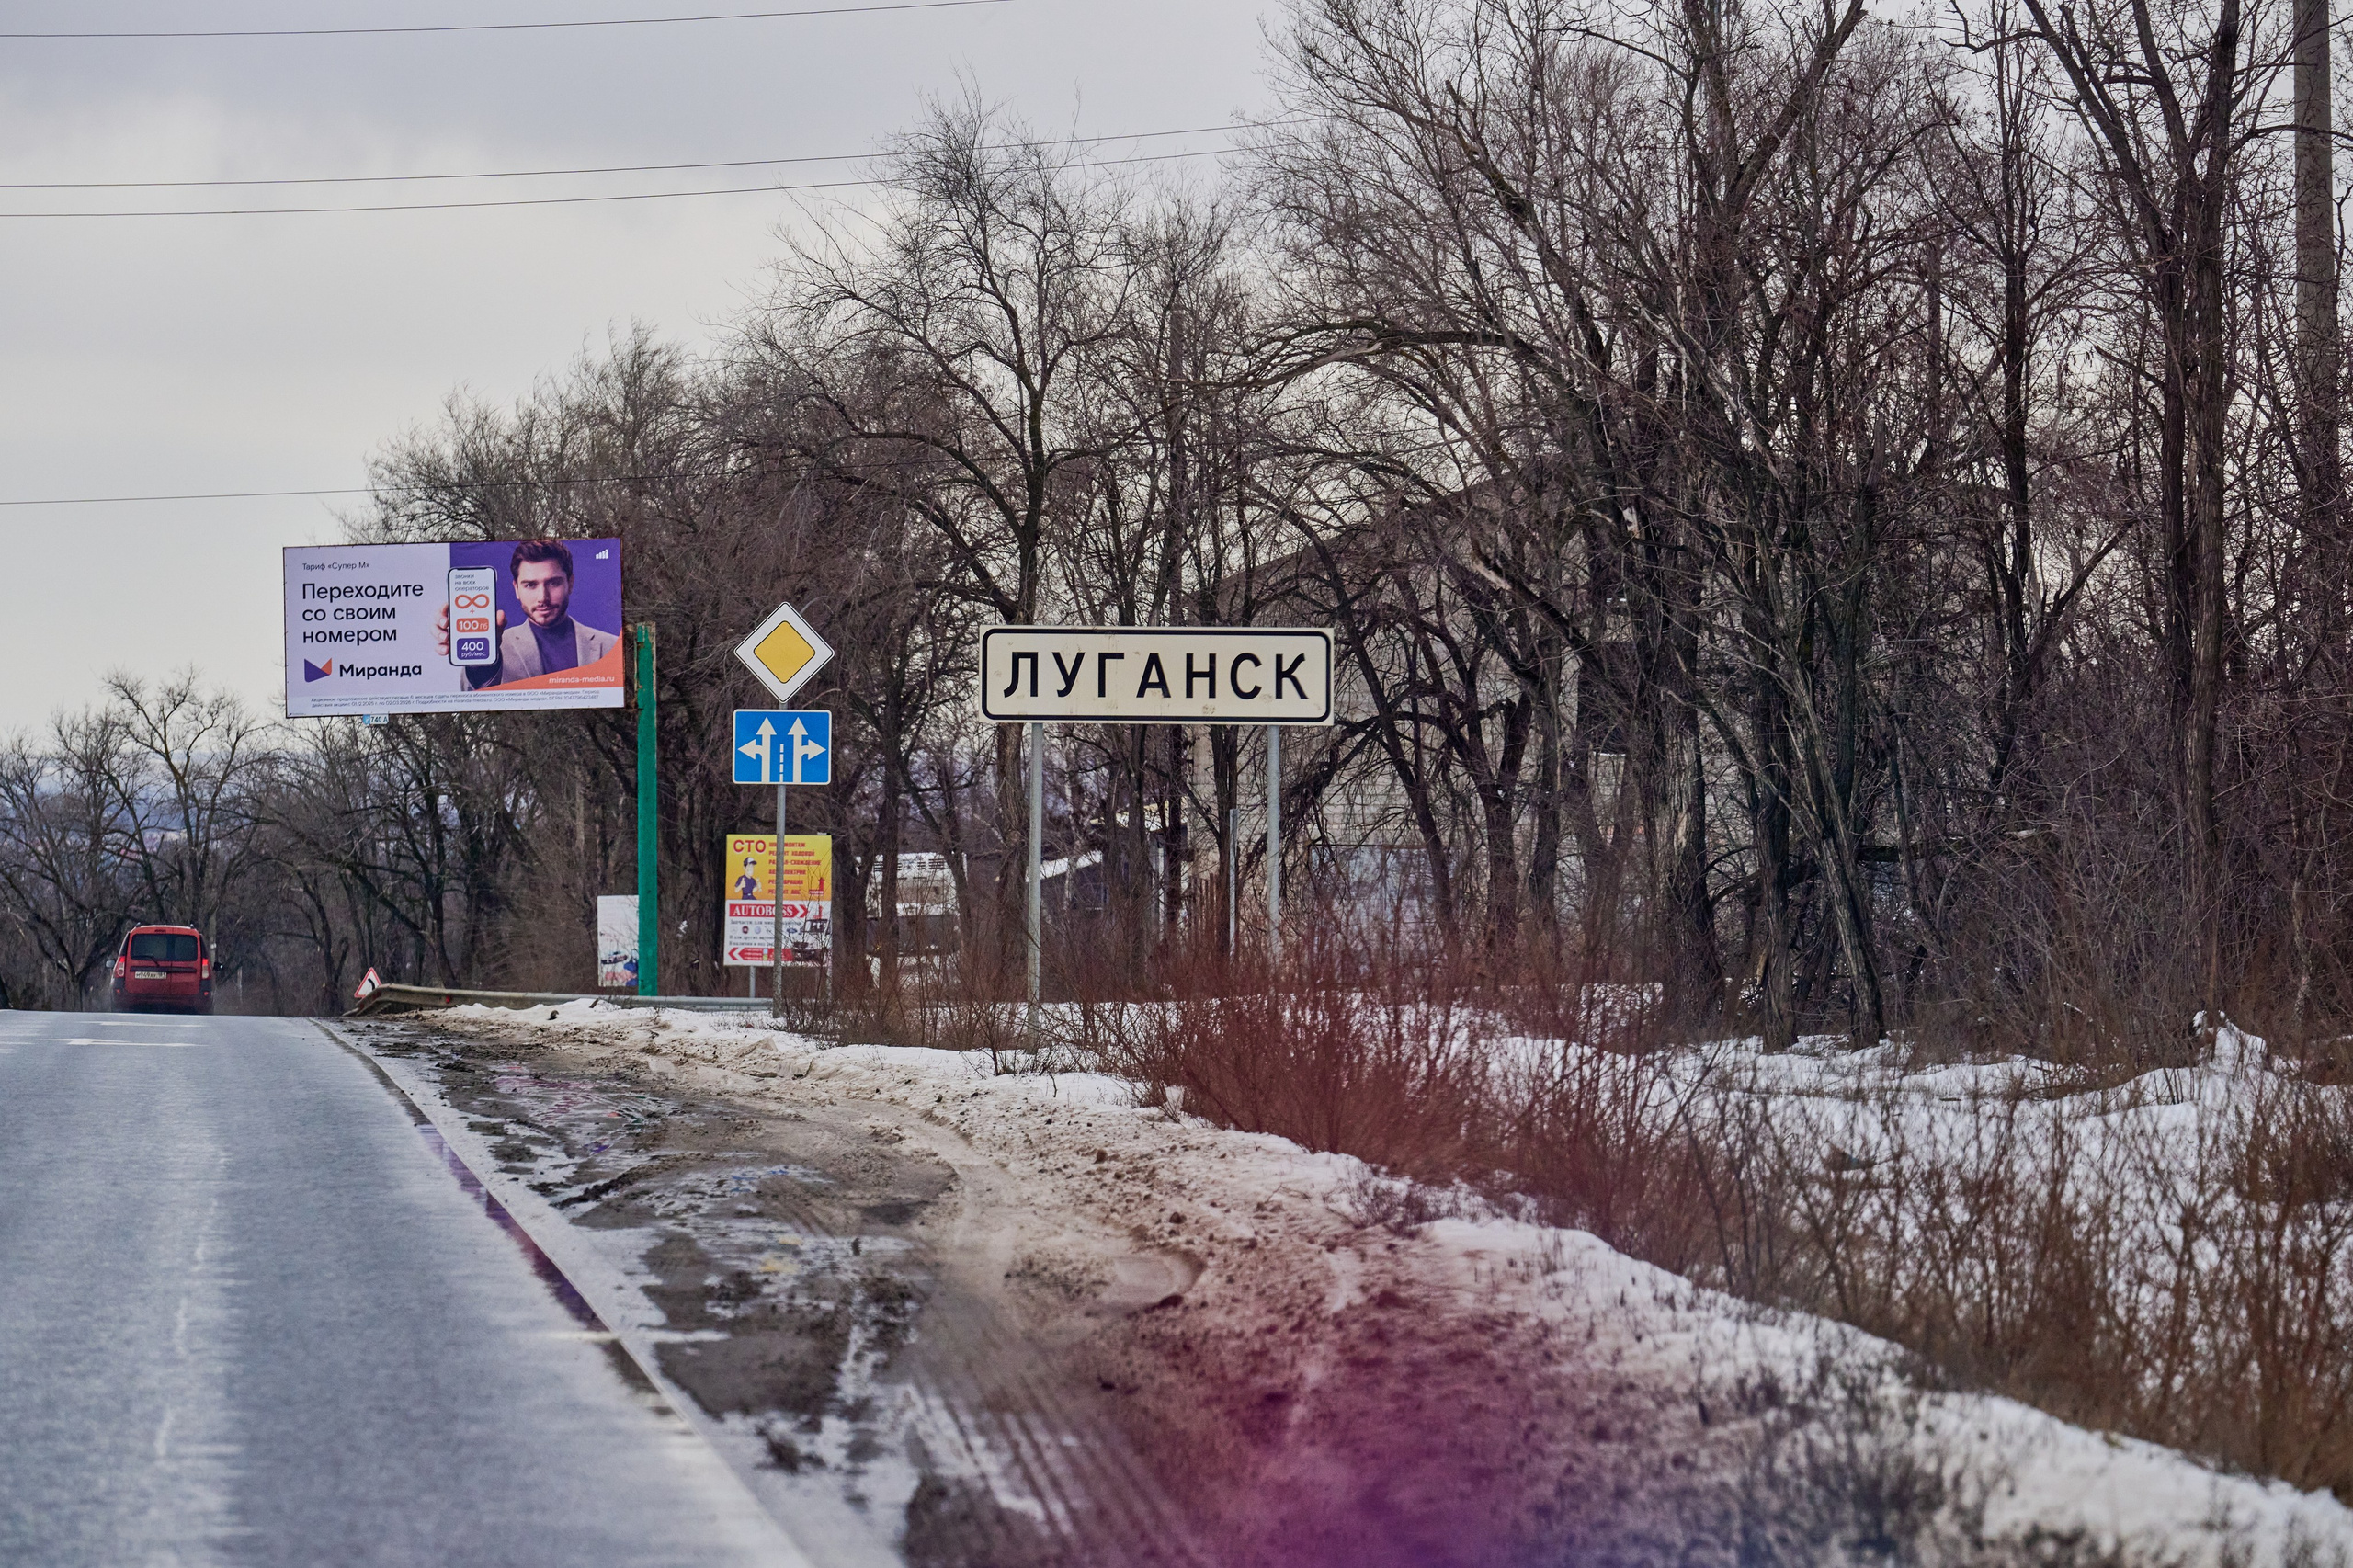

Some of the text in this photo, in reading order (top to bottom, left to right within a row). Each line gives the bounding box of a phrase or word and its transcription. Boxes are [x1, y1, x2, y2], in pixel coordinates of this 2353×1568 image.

[328, 562, 357, 570] «Супер
[302, 584, 424, 603] Переходите
[302, 607, 396, 621] со своим
[459, 620, 478, 630] 100
[303, 629, 397, 646] номером
[461, 642, 484, 651] 400
[339, 664, 422, 680] Миранда
[1004, 652, 1309, 699] ЛУГАНСК
[733, 840, 766, 852] СТО
